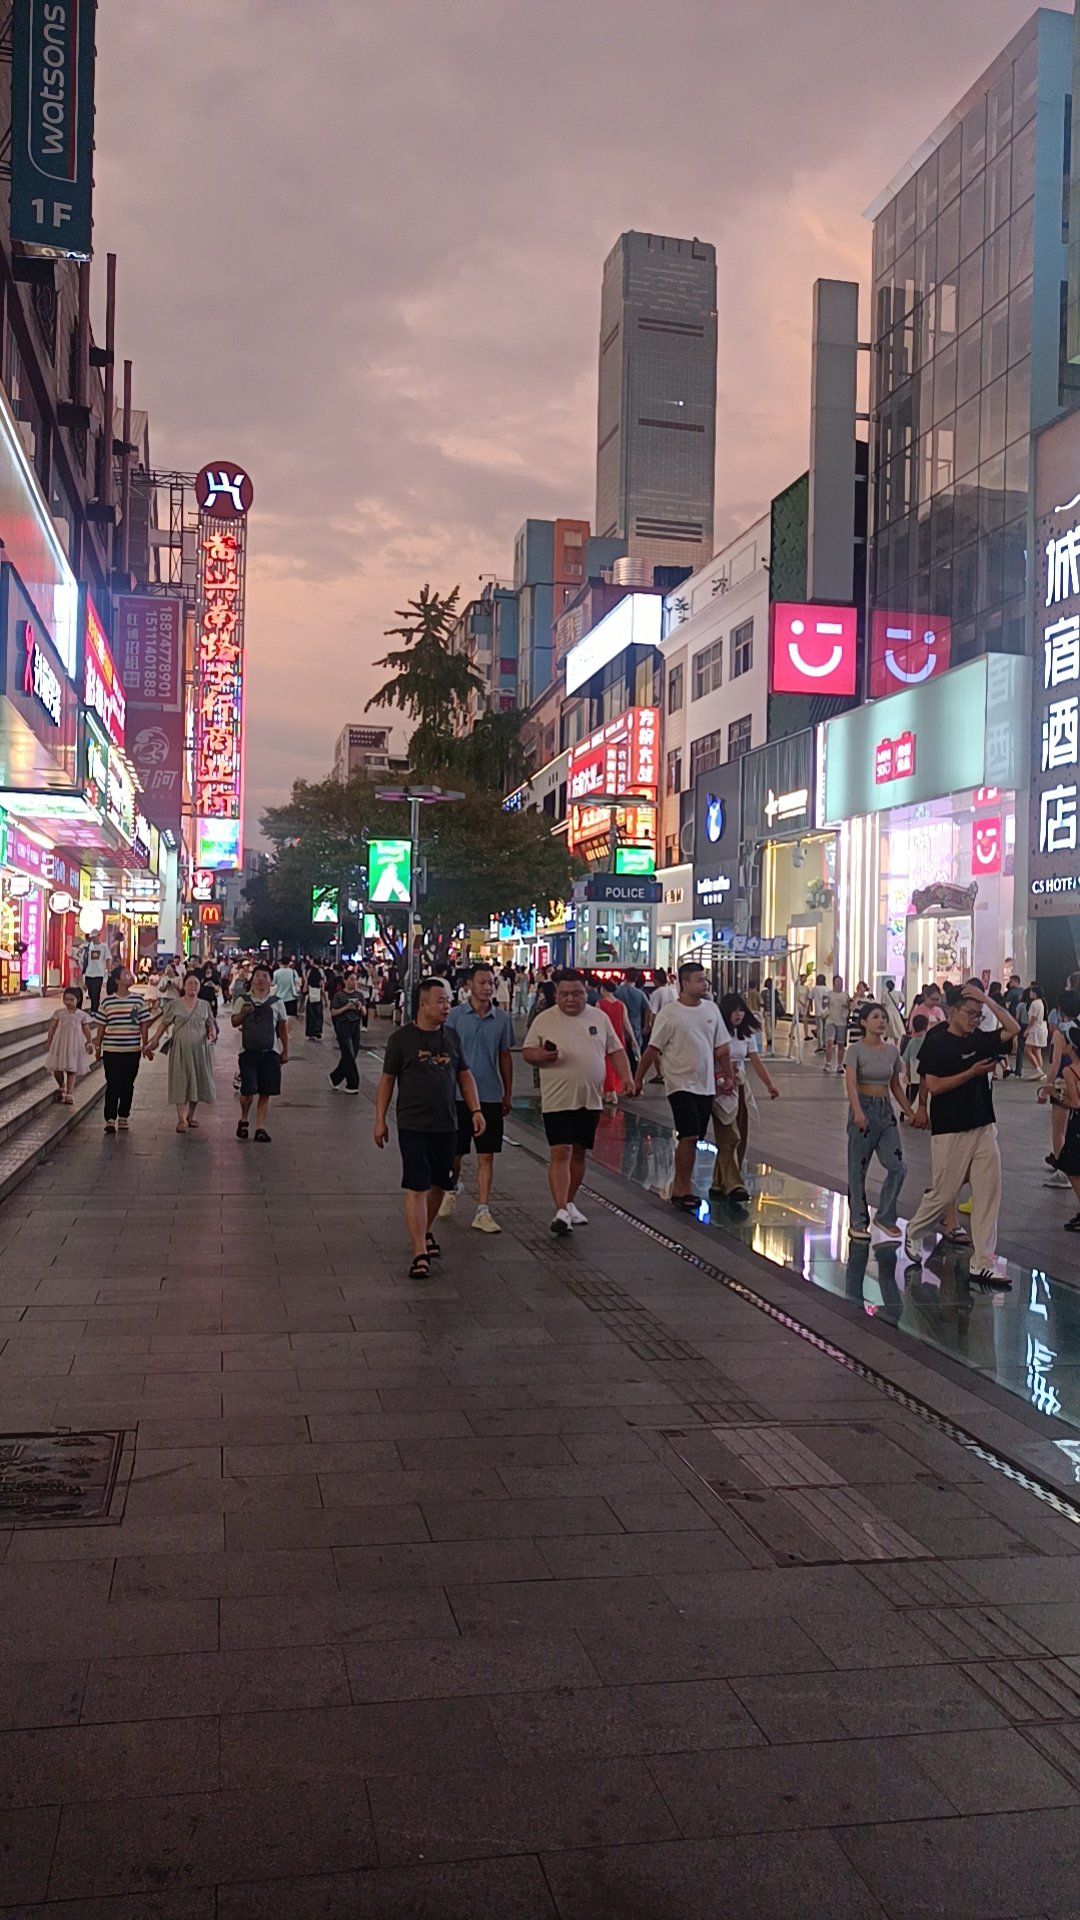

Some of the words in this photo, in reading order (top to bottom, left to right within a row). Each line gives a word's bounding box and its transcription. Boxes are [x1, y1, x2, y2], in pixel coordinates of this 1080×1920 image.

[40, 3, 66, 154] watsons
[31, 198, 73, 228] 1F
[143, 611, 158, 697] 15111401888
[158, 606, 172, 698] 18874778901
[605, 887, 645, 899] POLICE
